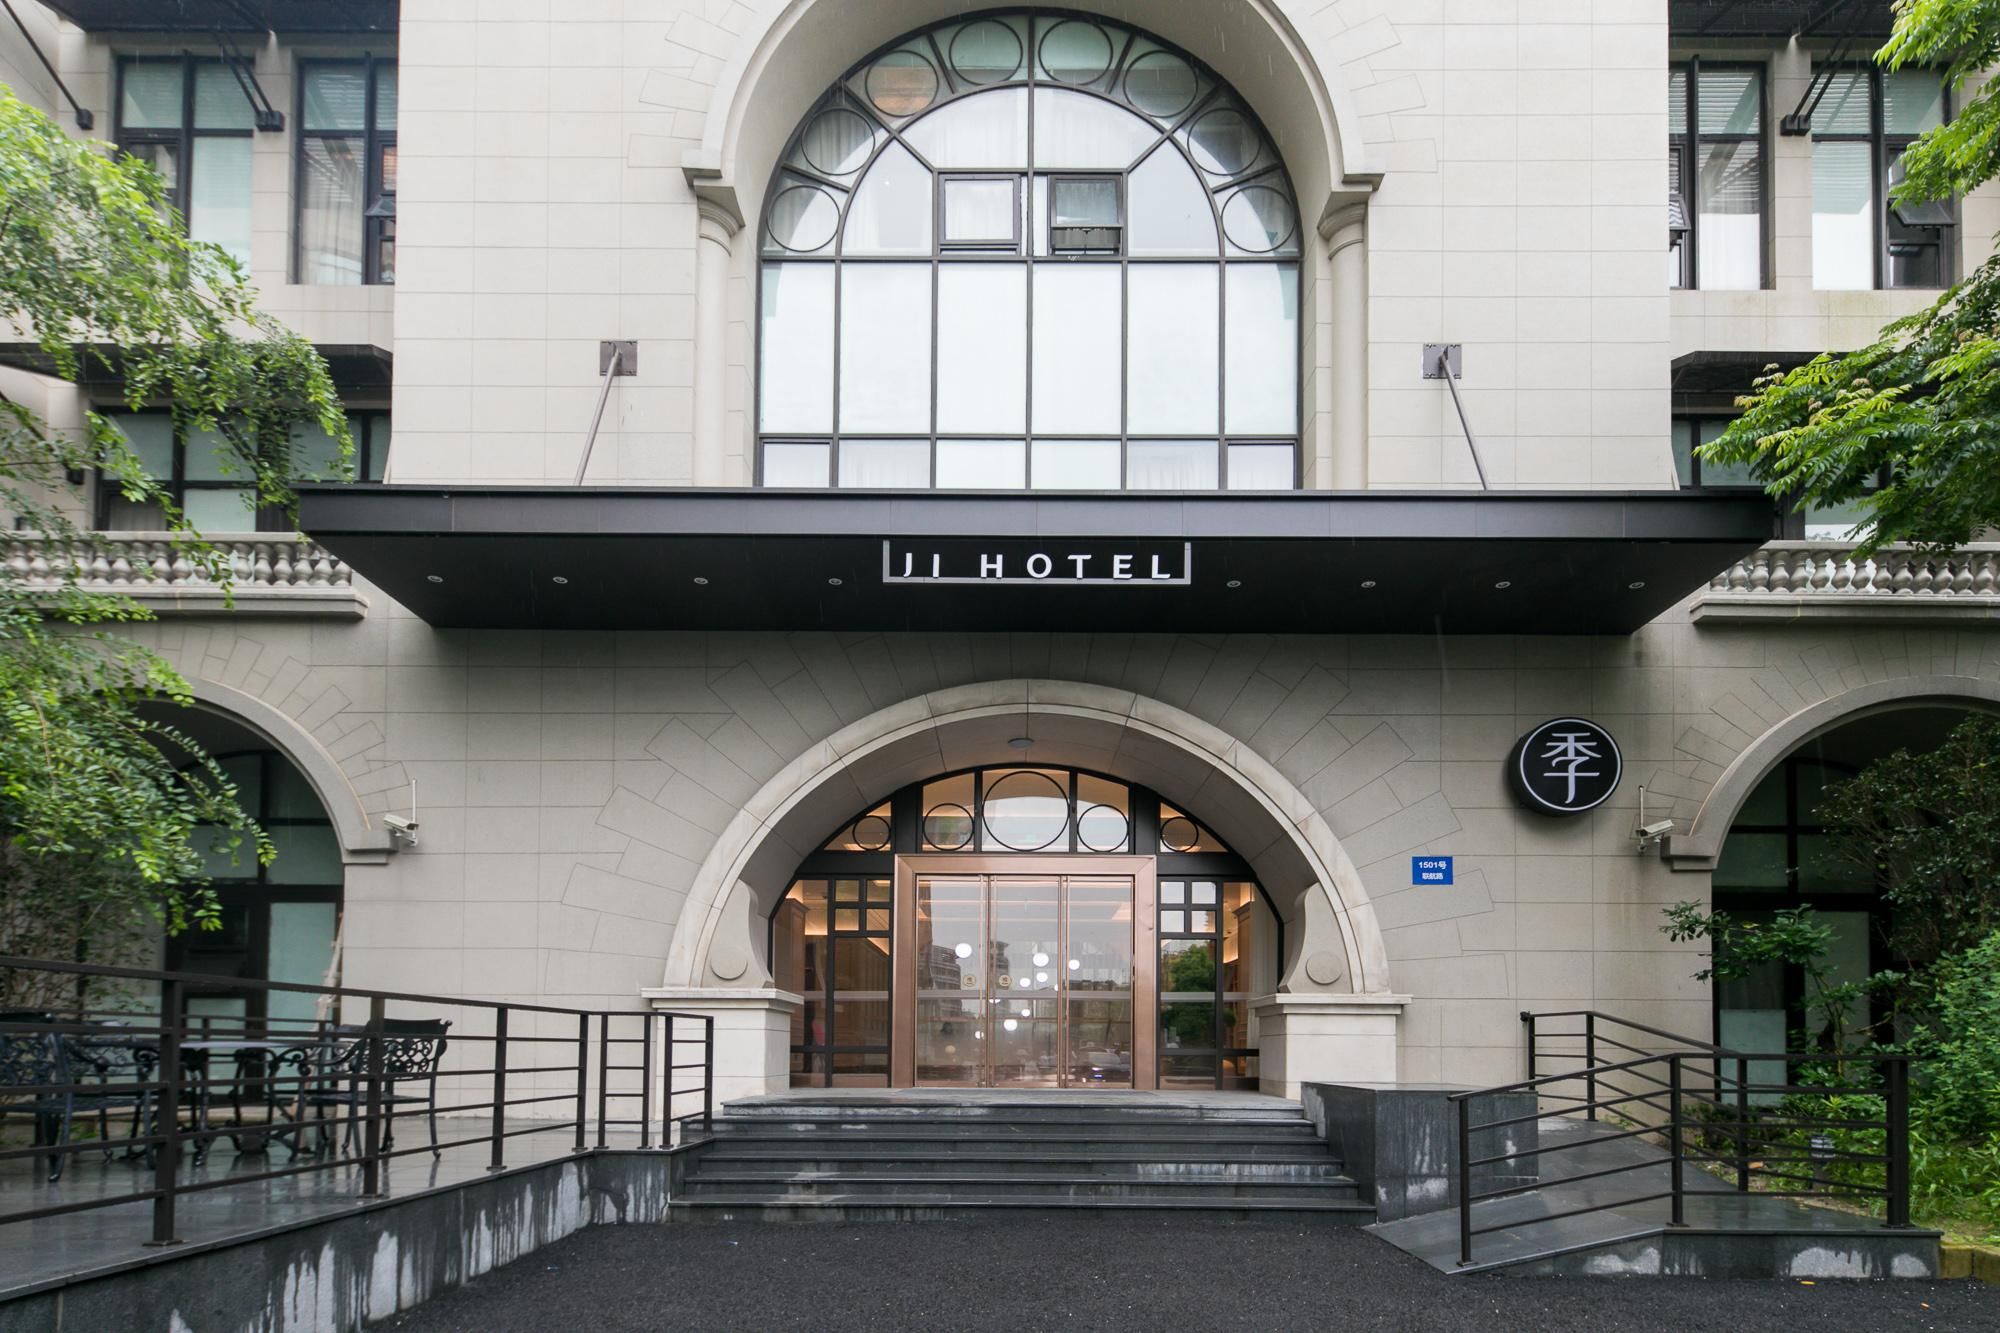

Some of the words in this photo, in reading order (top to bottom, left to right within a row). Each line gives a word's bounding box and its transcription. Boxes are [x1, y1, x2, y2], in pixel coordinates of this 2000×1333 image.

[903, 552, 940, 578] JI
[980, 553, 1171, 579] HOTEL
[1541, 732, 1602, 804] 季
